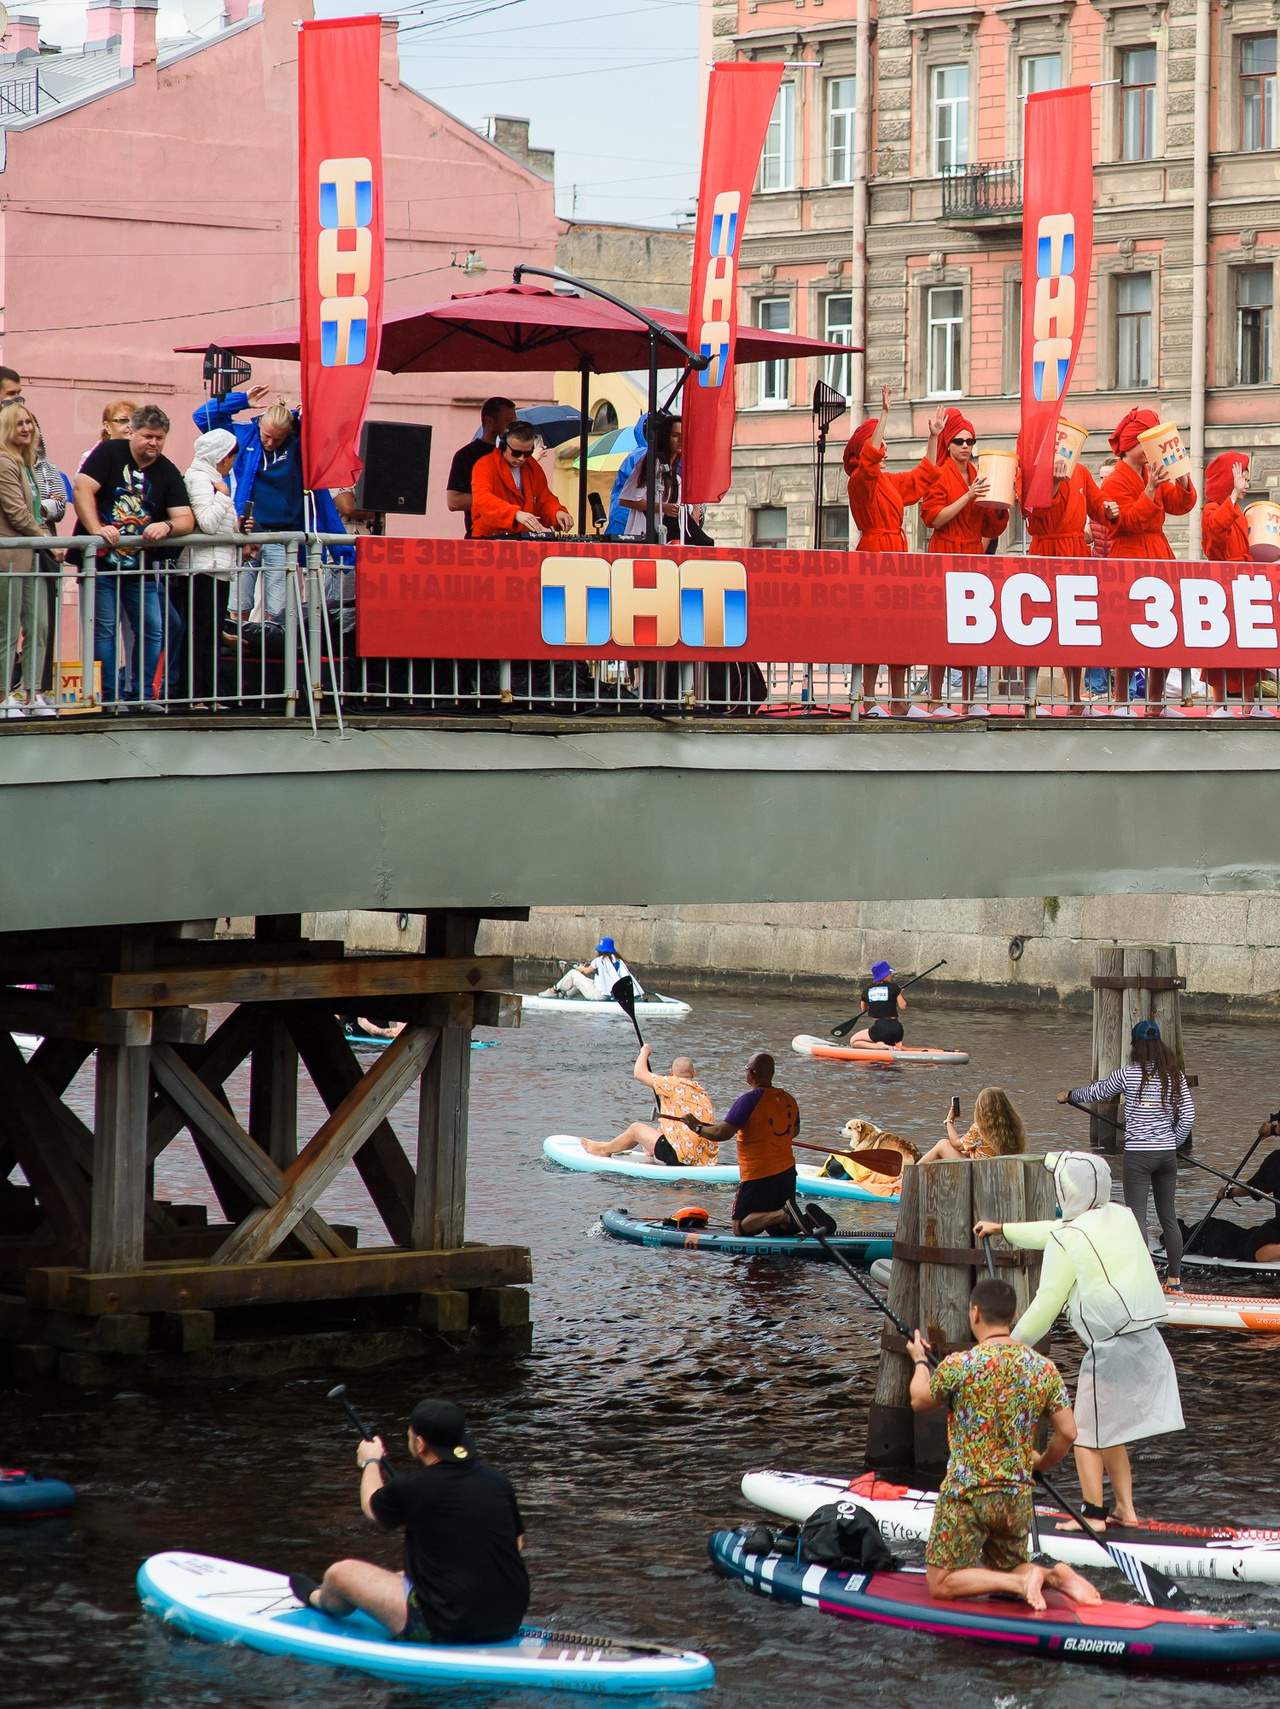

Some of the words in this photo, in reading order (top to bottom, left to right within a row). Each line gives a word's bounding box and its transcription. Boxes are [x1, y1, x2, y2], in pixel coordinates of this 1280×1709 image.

[318, 157, 373, 367] ТНТ
[698, 190, 741, 388] ТНТ
[1033, 212, 1076, 402] ТНТ
[540, 556, 748, 647] ТНТ
[859, 552, 943, 578] НАШИ
[945, 571, 1102, 647] ВСЕ
[877, 1519, 922, 1541] EYtex
